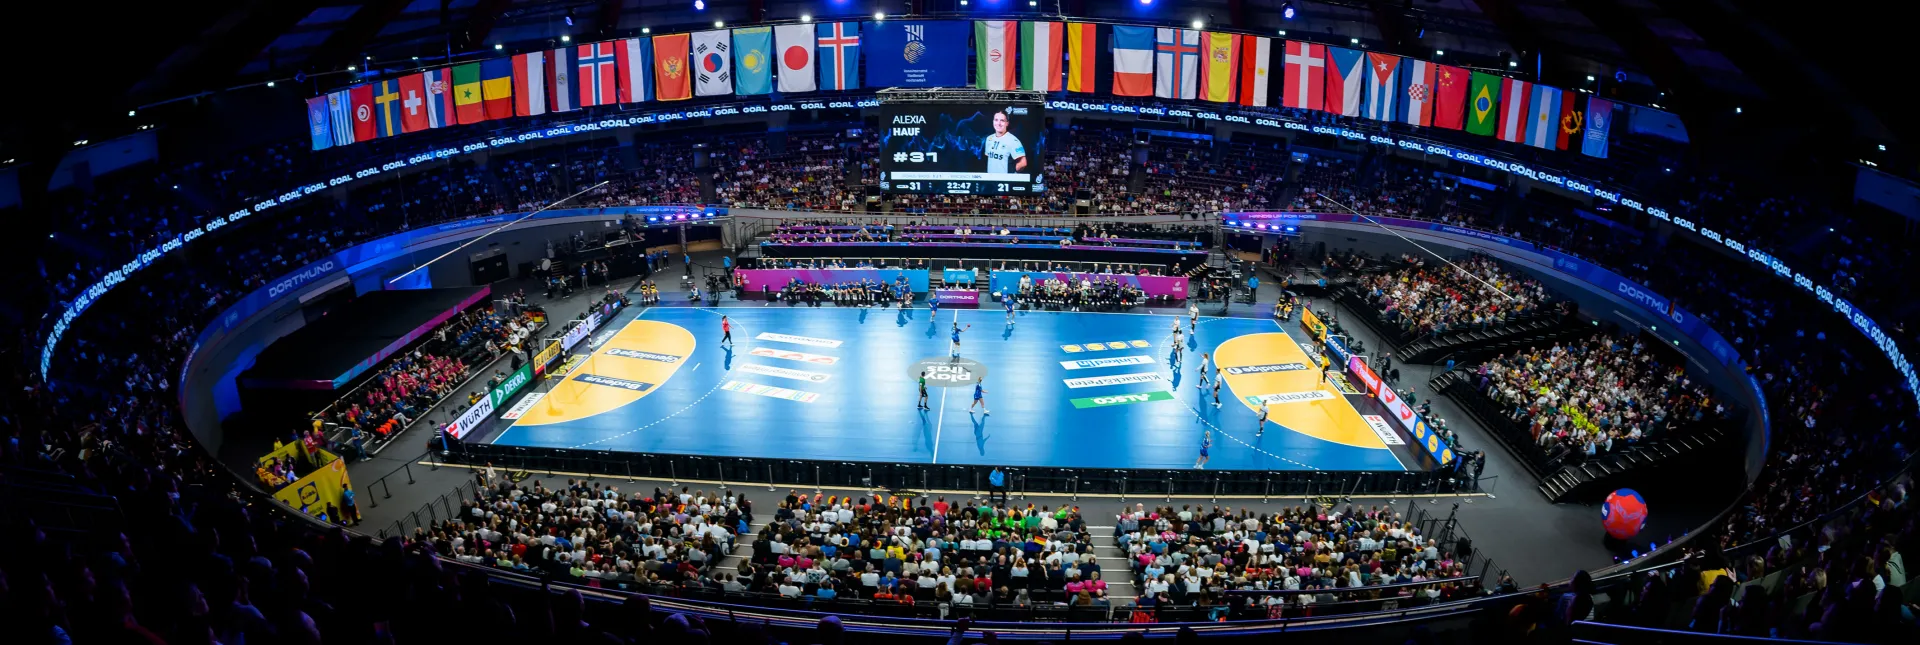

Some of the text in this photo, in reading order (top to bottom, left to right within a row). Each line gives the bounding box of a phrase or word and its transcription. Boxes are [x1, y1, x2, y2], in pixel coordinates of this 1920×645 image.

[893, 115, 926, 124] ALEXIA
[893, 128, 920, 136] HAUF
[893, 152, 938, 162] #31
[910, 182, 920, 190] 31
[998, 184, 1009, 192] 21
[76, 295, 89, 311] GOAL
[89, 282, 107, 299] GOAL
[104, 270, 125, 286] GOAL
[123, 259, 140, 274] GOAL
[142, 249, 161, 263] GOAL
[163, 238, 182, 252] GOAL
[184, 228, 204, 241] GOAL
[207, 218, 227, 231] GOAL
[229, 209, 250, 221] GOAL
[255, 199, 277, 211] GOAL
[280, 191, 301, 202] GOAL
[305, 183, 327, 194] GOAL
[330, 175, 352, 186] GOAL
[357, 168, 380, 178] GOAL
[383, 161, 406, 170] GOAL
[410, 154, 432, 164] GOAL
[436, 148, 460, 157] GOAL
[464, 142, 488, 151] GOAL
[491, 137, 515, 145] GOAL
[519, 132, 543, 140] GOAL
[547, 128, 571, 136] GOAL
[574, 123, 601, 131] GOAL
[600, 119, 630, 128] GOAL
[629, 116, 654, 124] GOAL
[658, 113, 683, 121] GOAL
[715, 107, 739, 115] GOAL
[1053, 101, 1082, 111] GOAL
[1140, 107, 1164, 115] GOAL
[1225, 115, 1250, 123] GOAL
[1256, 119, 1281, 127] GOAL
[1285, 123, 1309, 131] GOAL
[1313, 127, 1337, 135] GOAL
[1342, 131, 1366, 139] GOAL
[1371, 136, 1395, 145] GOAL
[1399, 140, 1424, 150] GOAL
[1427, 146, 1452, 157] GOAL
[1457, 153, 1480, 163] GOAL
[1484, 159, 1510, 171] GOAL
[1510, 164, 1538, 180] GOAL
[1539, 172, 1562, 184] GOAL
[1567, 180, 1590, 193] GOAL
[1595, 189, 1617, 202] GOAL
[1622, 199, 1643, 211] GOAL
[1648, 207, 1670, 221] GOAL
[1674, 217, 1696, 231] GOAL
[1701, 228, 1722, 243] GOAL
[1726, 239, 1745, 254] GOAL
[1749, 250, 1768, 265] GOAL
[1772, 261, 1791, 277] GOAL
[1795, 273, 1813, 291] GOAL
[1816, 286, 1833, 304] GOAL
[1836, 299, 1851, 319] GOAL
[1854, 313, 1869, 333] GOAL
[1871, 327, 1886, 351] GOAL
[1886, 338, 1900, 370] GOAL
[269, 260, 334, 298] DORTMUND
[620, 350, 680, 362] Gjensidige
[1242, 364, 1308, 372] Gjensidige
[925, 372, 970, 382] play
[1070, 374, 1160, 386] Kieback&Peter
[504, 372, 526, 394] DEKRA
[584, 376, 642, 390] Buderus
[1093, 393, 1151, 404] ALSCO
[1268, 391, 1324, 402] gorenje
[460, 400, 490, 431] WÜRTH
